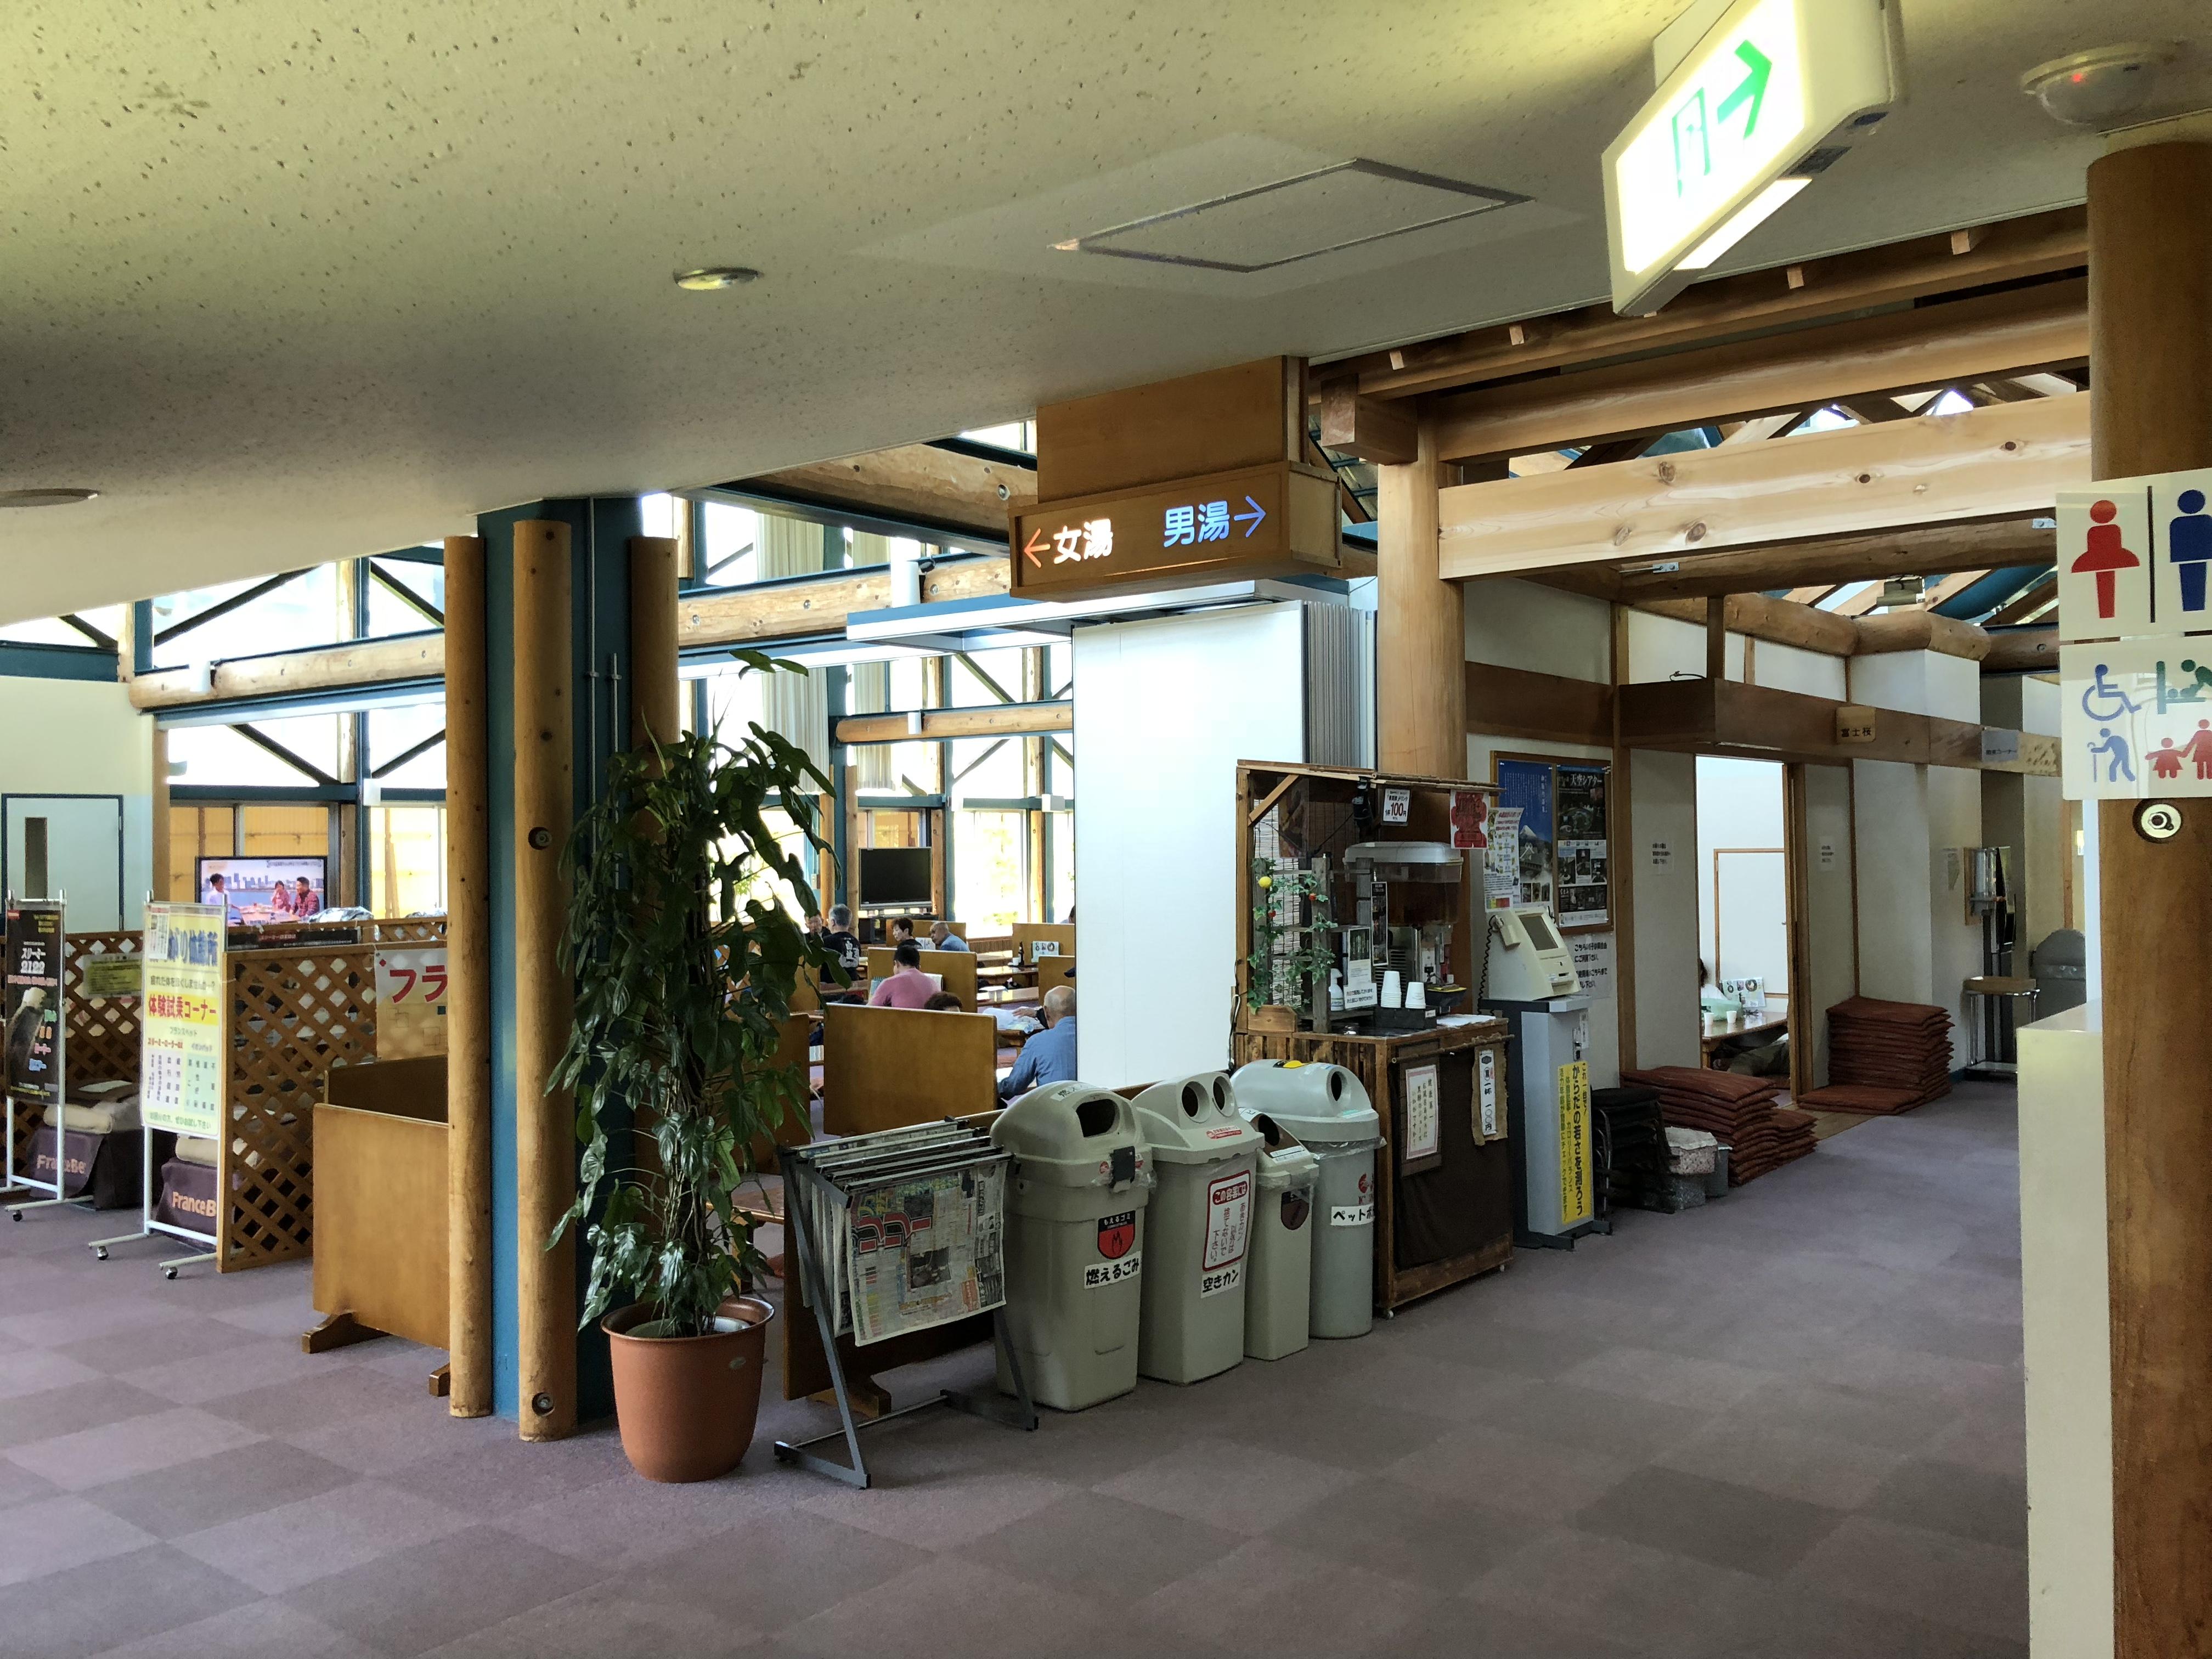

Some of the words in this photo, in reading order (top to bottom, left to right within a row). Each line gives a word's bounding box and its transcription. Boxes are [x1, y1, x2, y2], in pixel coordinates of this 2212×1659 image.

[1163, 500, 1230, 548] 男湯
[1053, 518, 1113, 565] 女湯
[1841, 727, 1871, 738] 富士桜
[389, 964, 448, 1003] フラ
[149, 994, 216, 1021] 体験試乗コーナー
[1104, 1213, 1131, 1226] もえるゴミ
[1086, 1257, 1139, 1286] 燃えるごみ
[1201, 1269, 1239, 1294] 空きカン
